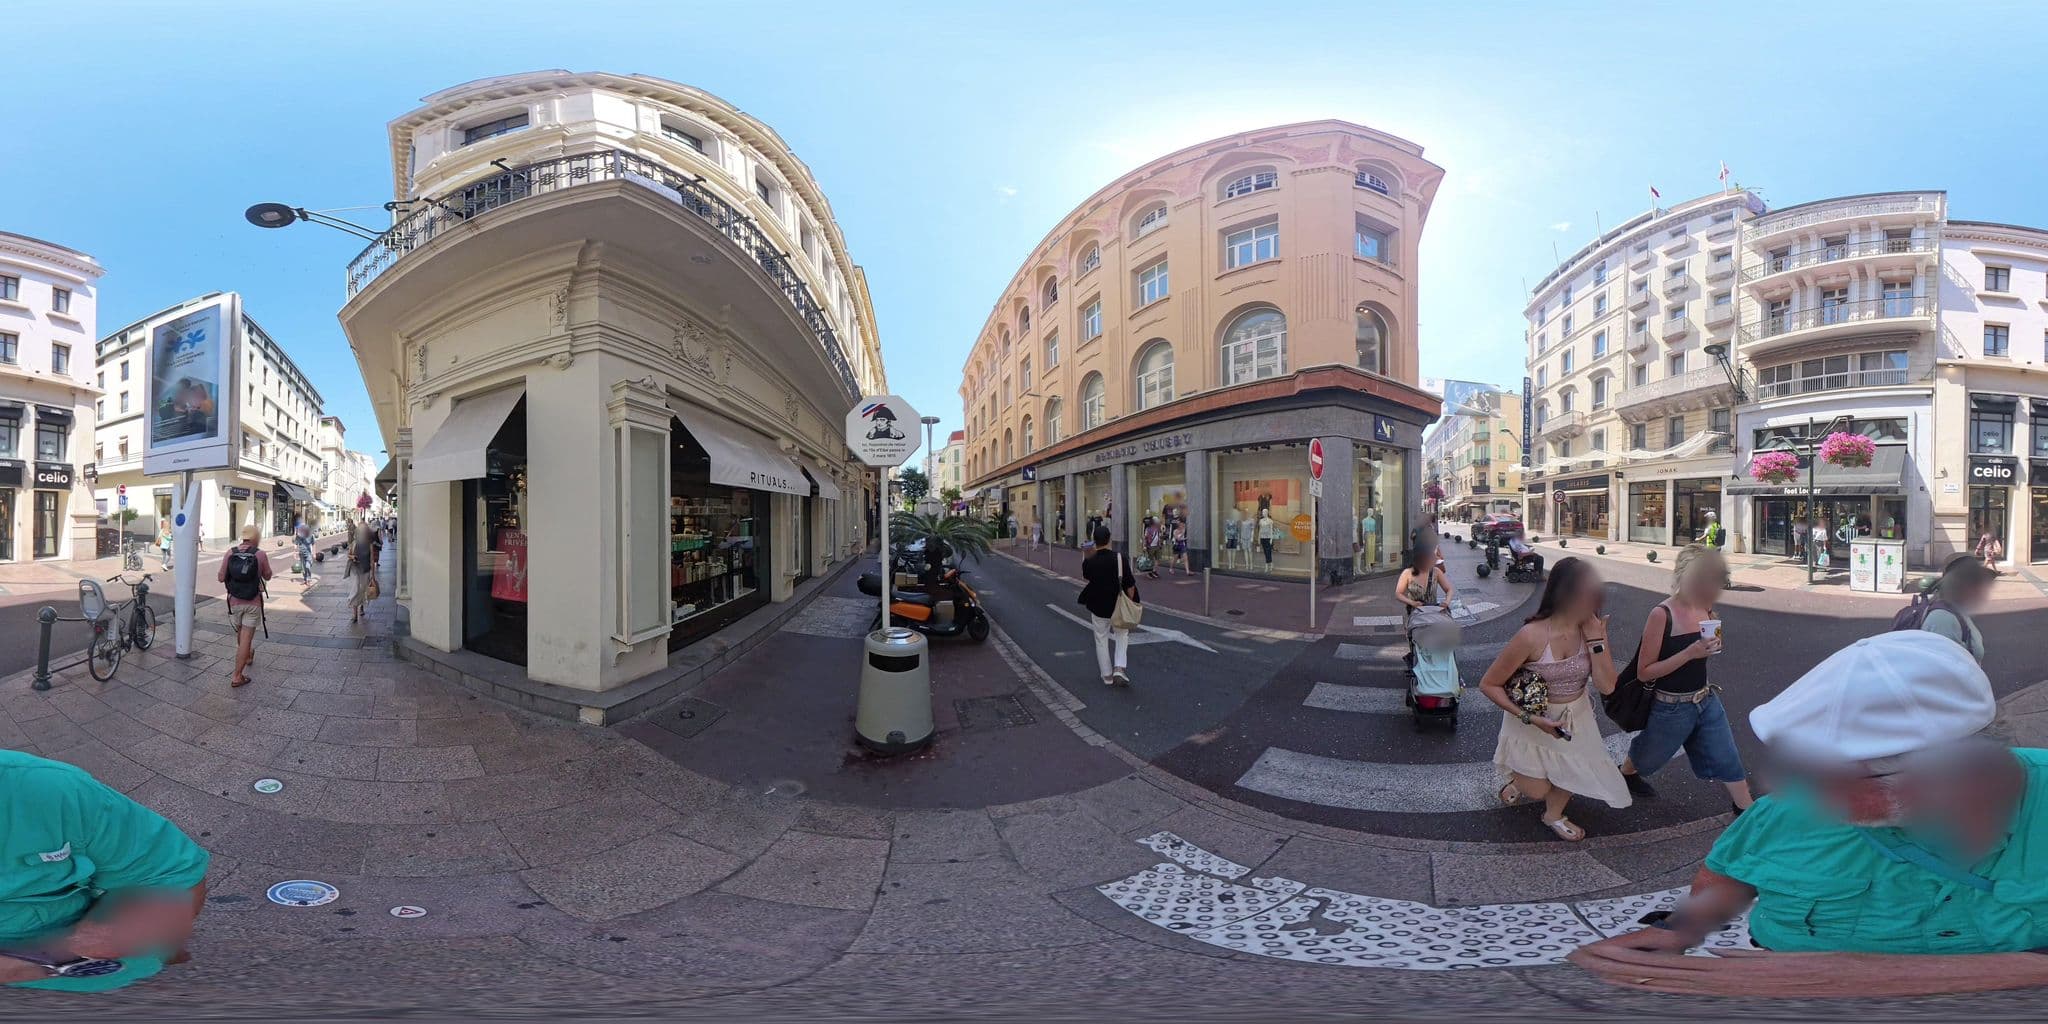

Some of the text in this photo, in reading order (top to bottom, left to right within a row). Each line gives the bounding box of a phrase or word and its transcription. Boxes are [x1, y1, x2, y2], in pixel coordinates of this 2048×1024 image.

[1973, 465, 2012, 478] celio
[38, 472, 69, 484] celio
[1784, 487, 1822, 495] Foot Locer
